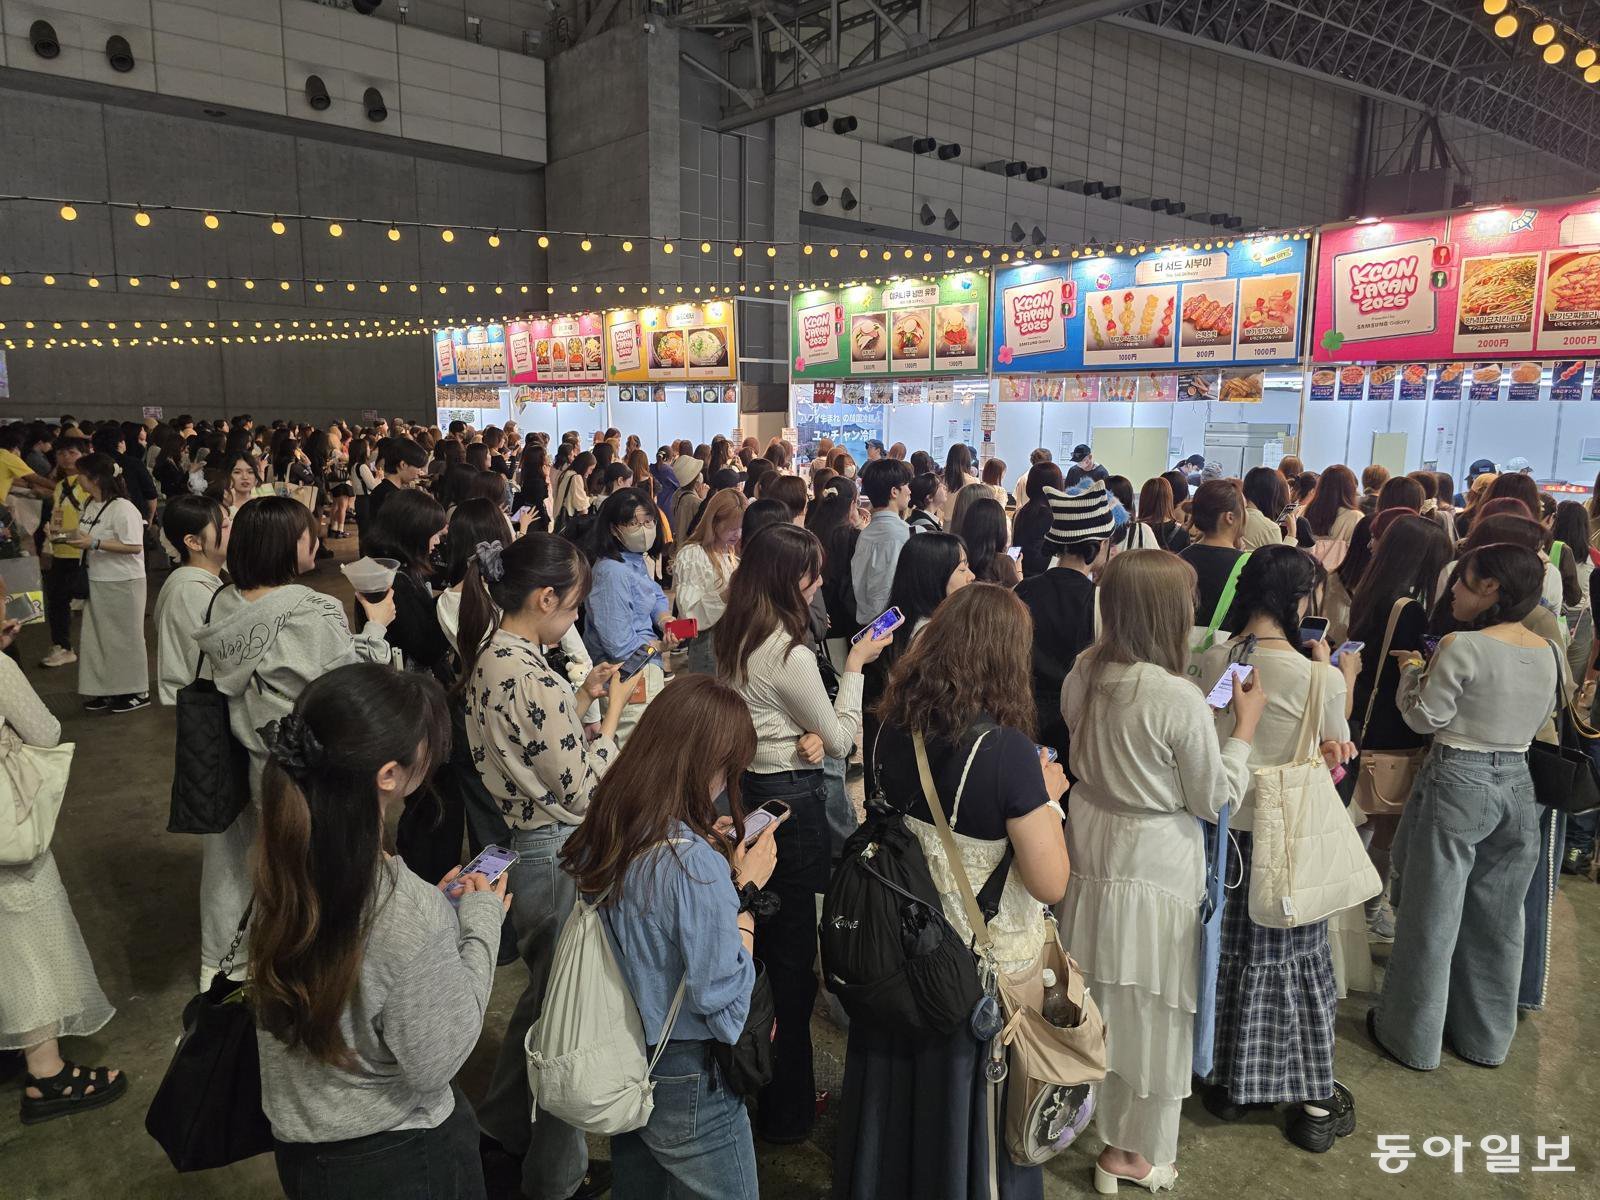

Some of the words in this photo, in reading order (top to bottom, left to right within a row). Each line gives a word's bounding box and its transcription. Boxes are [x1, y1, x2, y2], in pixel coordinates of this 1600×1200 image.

[1154, 262, 1163, 272] 더
[1165, 260, 1182, 271] 서드
[1185, 258, 1212, 269] 시부야
[1351, 256, 1418, 286] KCON
[1352, 277, 1417, 301] JAPAN
[1014, 291, 1053, 312] KCON
[1360, 294, 1407, 312] 2026
[804, 312, 830, 329] KCON
[1015, 306, 1053, 324] JAPAN
[1020, 320, 1048, 333] 2026
[1356, 321, 1388, 330] SAMSUNG
[1389, 319, 1411, 327] Galaxy
[805, 326, 830, 340] JAPAN
[809, 336, 828, 347] 2026
[1478, 338, 1509, 348] 2000円
[1563, 335, 1597, 346] 2000円
[1196, 350, 1215, 358] 800円
[1254, 348, 1276, 356] 1000円
